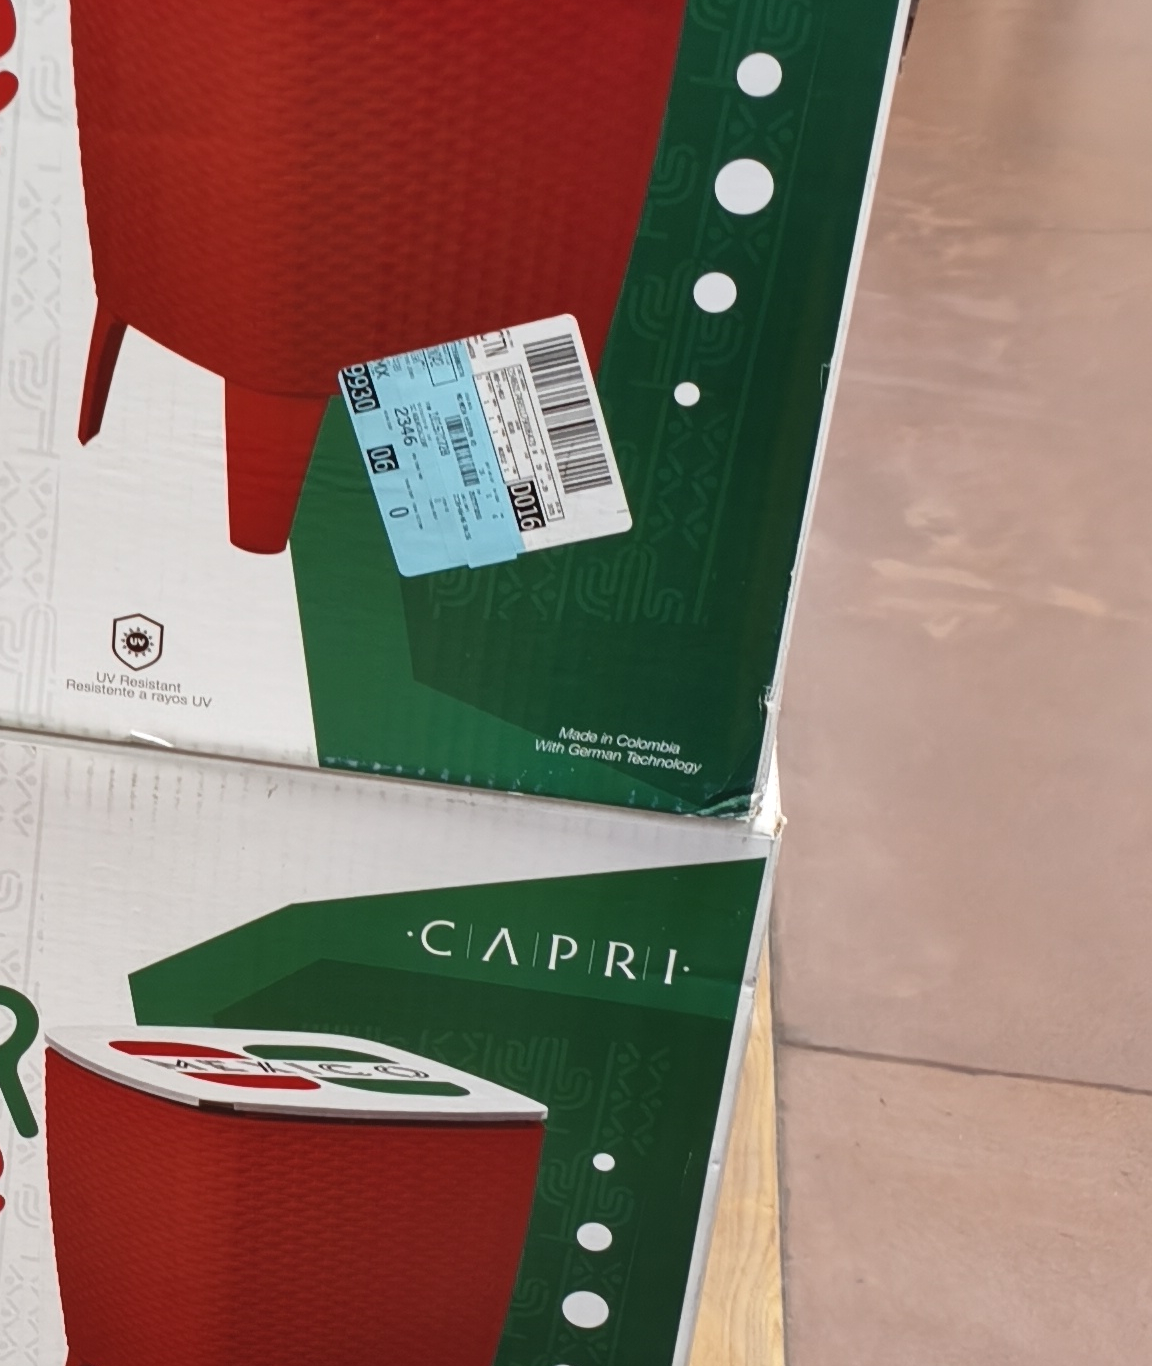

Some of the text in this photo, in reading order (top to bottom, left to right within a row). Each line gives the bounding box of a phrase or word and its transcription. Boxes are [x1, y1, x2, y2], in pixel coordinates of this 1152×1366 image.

[394, 407, 418, 447] 2346
[369, 446, 398, 473] 06
[512, 482, 539, 531] D016
[66, 679, 212, 708] Resistente rayos UV
[96, 672, 181, 693] UV Resistant
[559, 727, 681, 755] Made in Colombia
[535, 739, 702, 775] With German Technology
